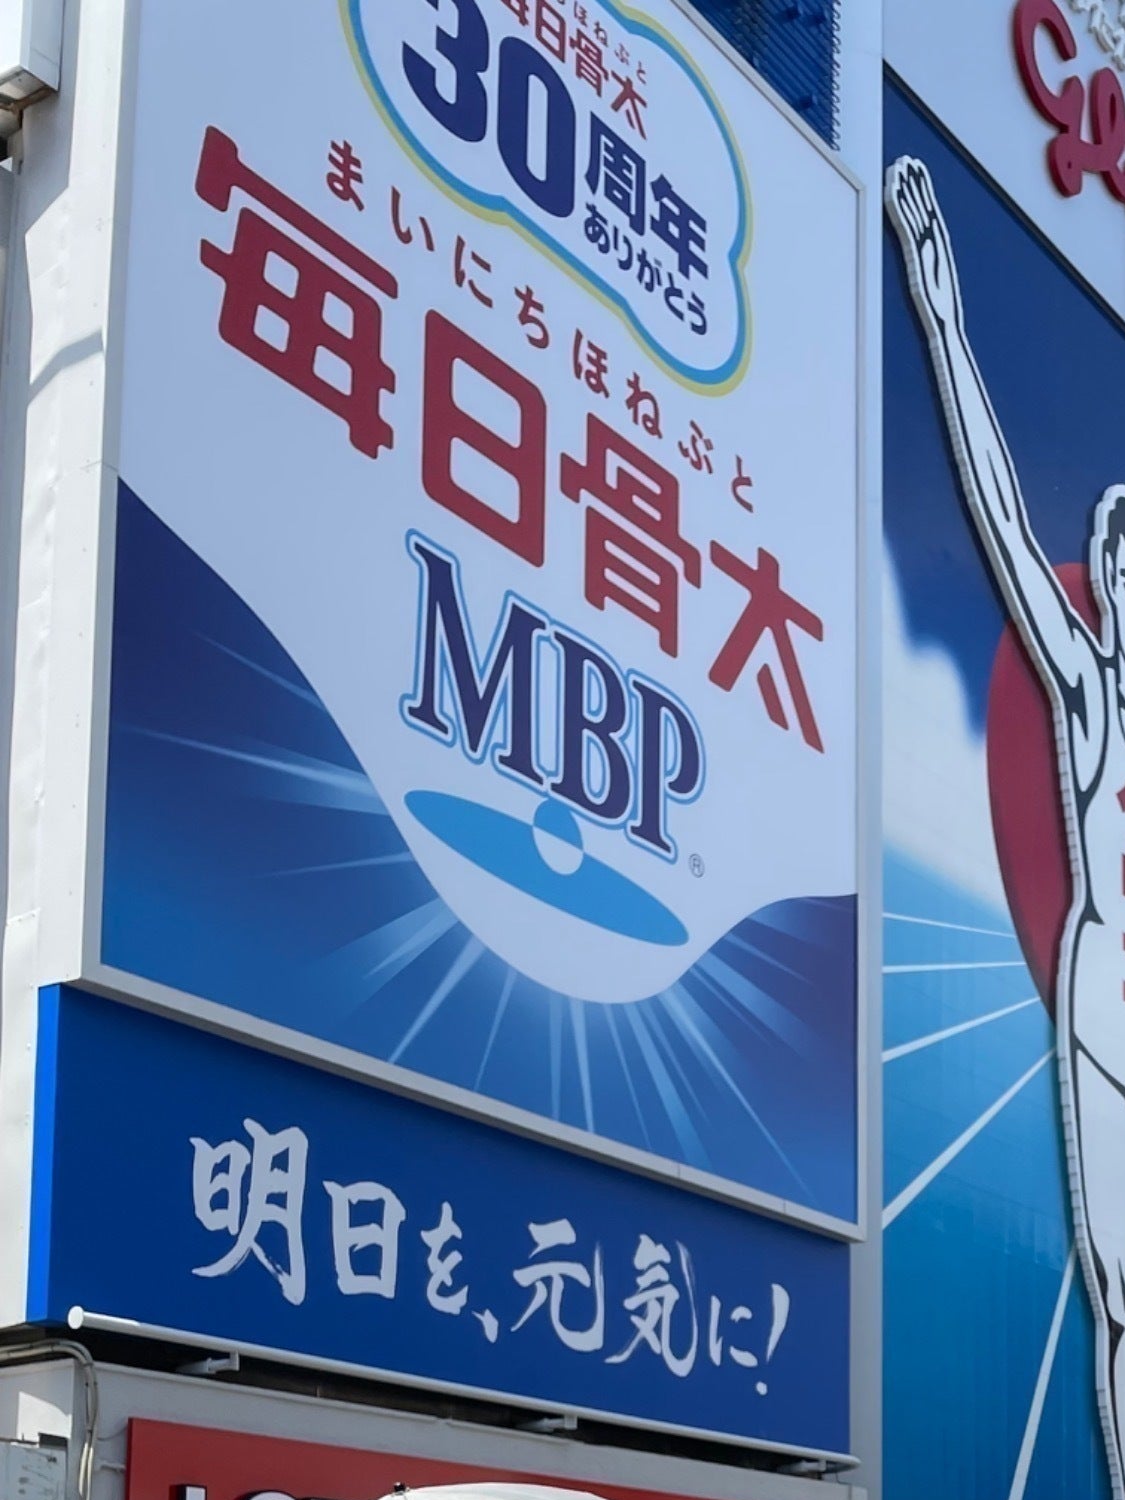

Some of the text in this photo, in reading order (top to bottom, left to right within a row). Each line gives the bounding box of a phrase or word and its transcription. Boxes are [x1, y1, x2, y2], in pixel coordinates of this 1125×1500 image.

[195, 126, 825, 754] 毎日骨太
[329, 140, 754, 513] まいにちほねぶと
[584, 202, 707, 336] ありがとう
[402, 530, 704, 862] MBP
